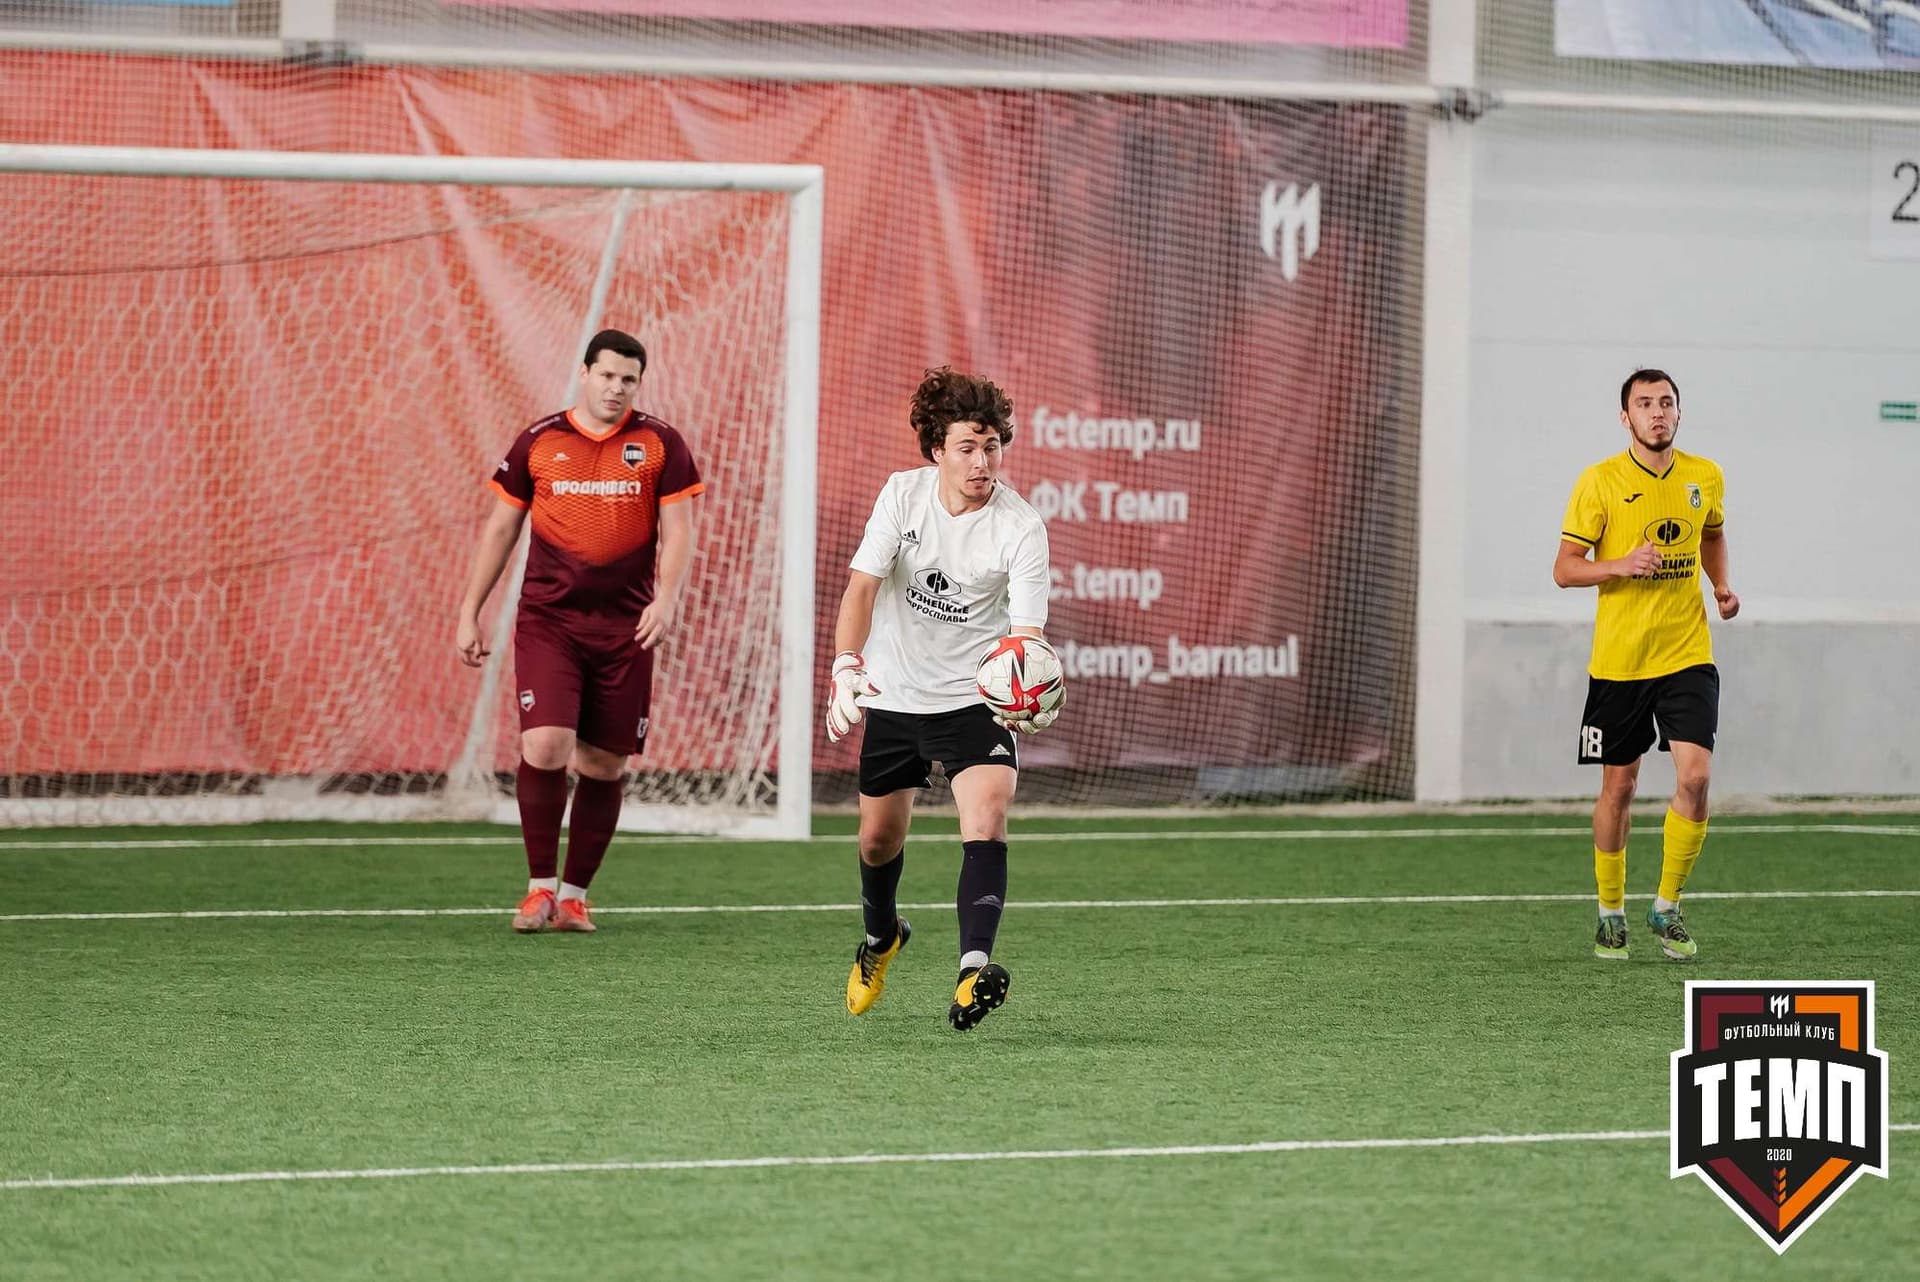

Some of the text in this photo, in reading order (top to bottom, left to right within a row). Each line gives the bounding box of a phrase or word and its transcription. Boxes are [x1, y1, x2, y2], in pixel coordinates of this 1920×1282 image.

[1031, 408, 1201, 461] fctemp.ru
[1030, 479, 1189, 522] ФК Темп
[1049, 561, 1164, 610] c.temp
[906, 596, 968, 623] РРОСПЛАВЫ
[1055, 634, 1299, 688] temp_barnaul
[1581, 725, 1603, 758] 18
